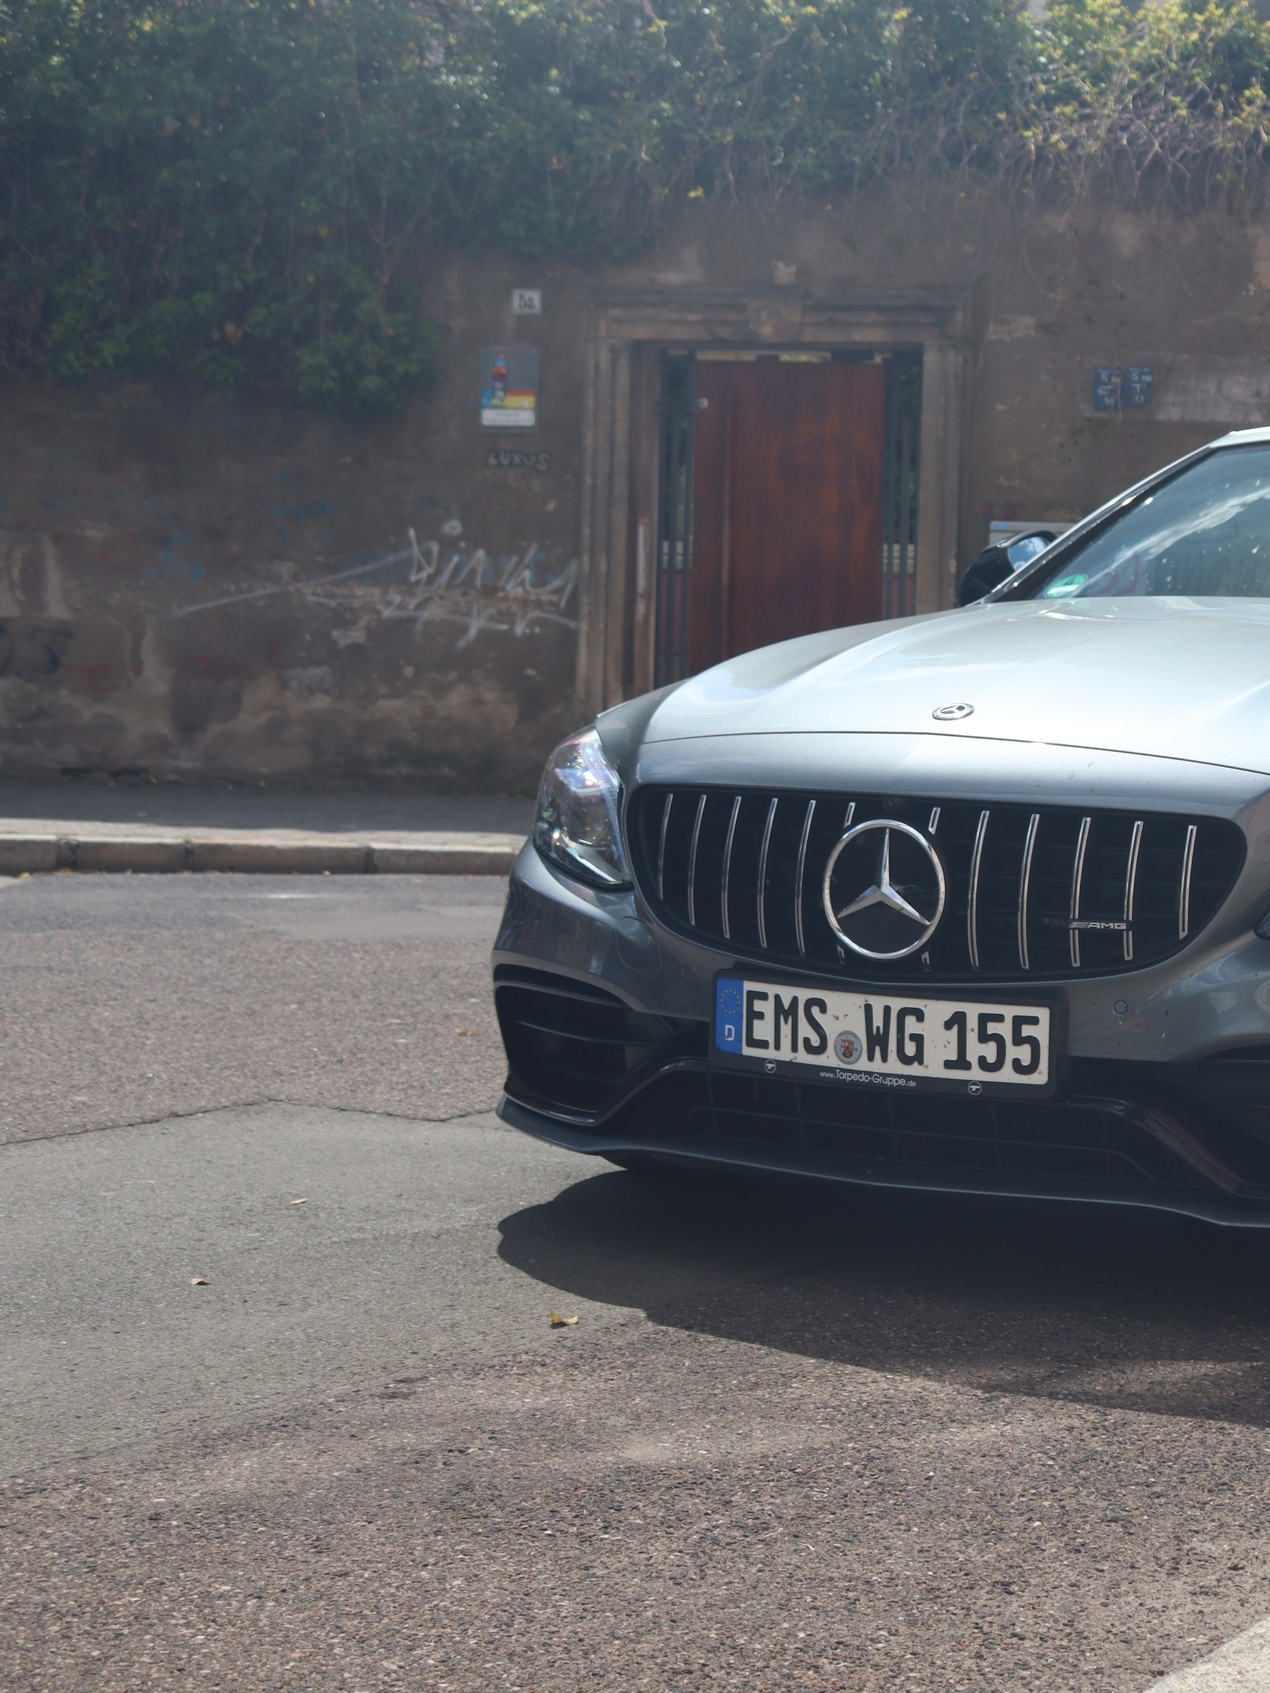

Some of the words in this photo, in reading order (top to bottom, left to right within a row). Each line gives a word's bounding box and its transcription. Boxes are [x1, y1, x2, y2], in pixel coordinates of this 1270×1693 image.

[1086, 922, 1127, 930] AMG
[724, 1025, 736, 1042] D
[745, 989, 829, 1056] EMS
[864, 1002, 926, 1067] WG
[943, 1010, 1041, 1076] 155
[819, 1069, 917, 1088] www.Torpedo-Gruppe.de
